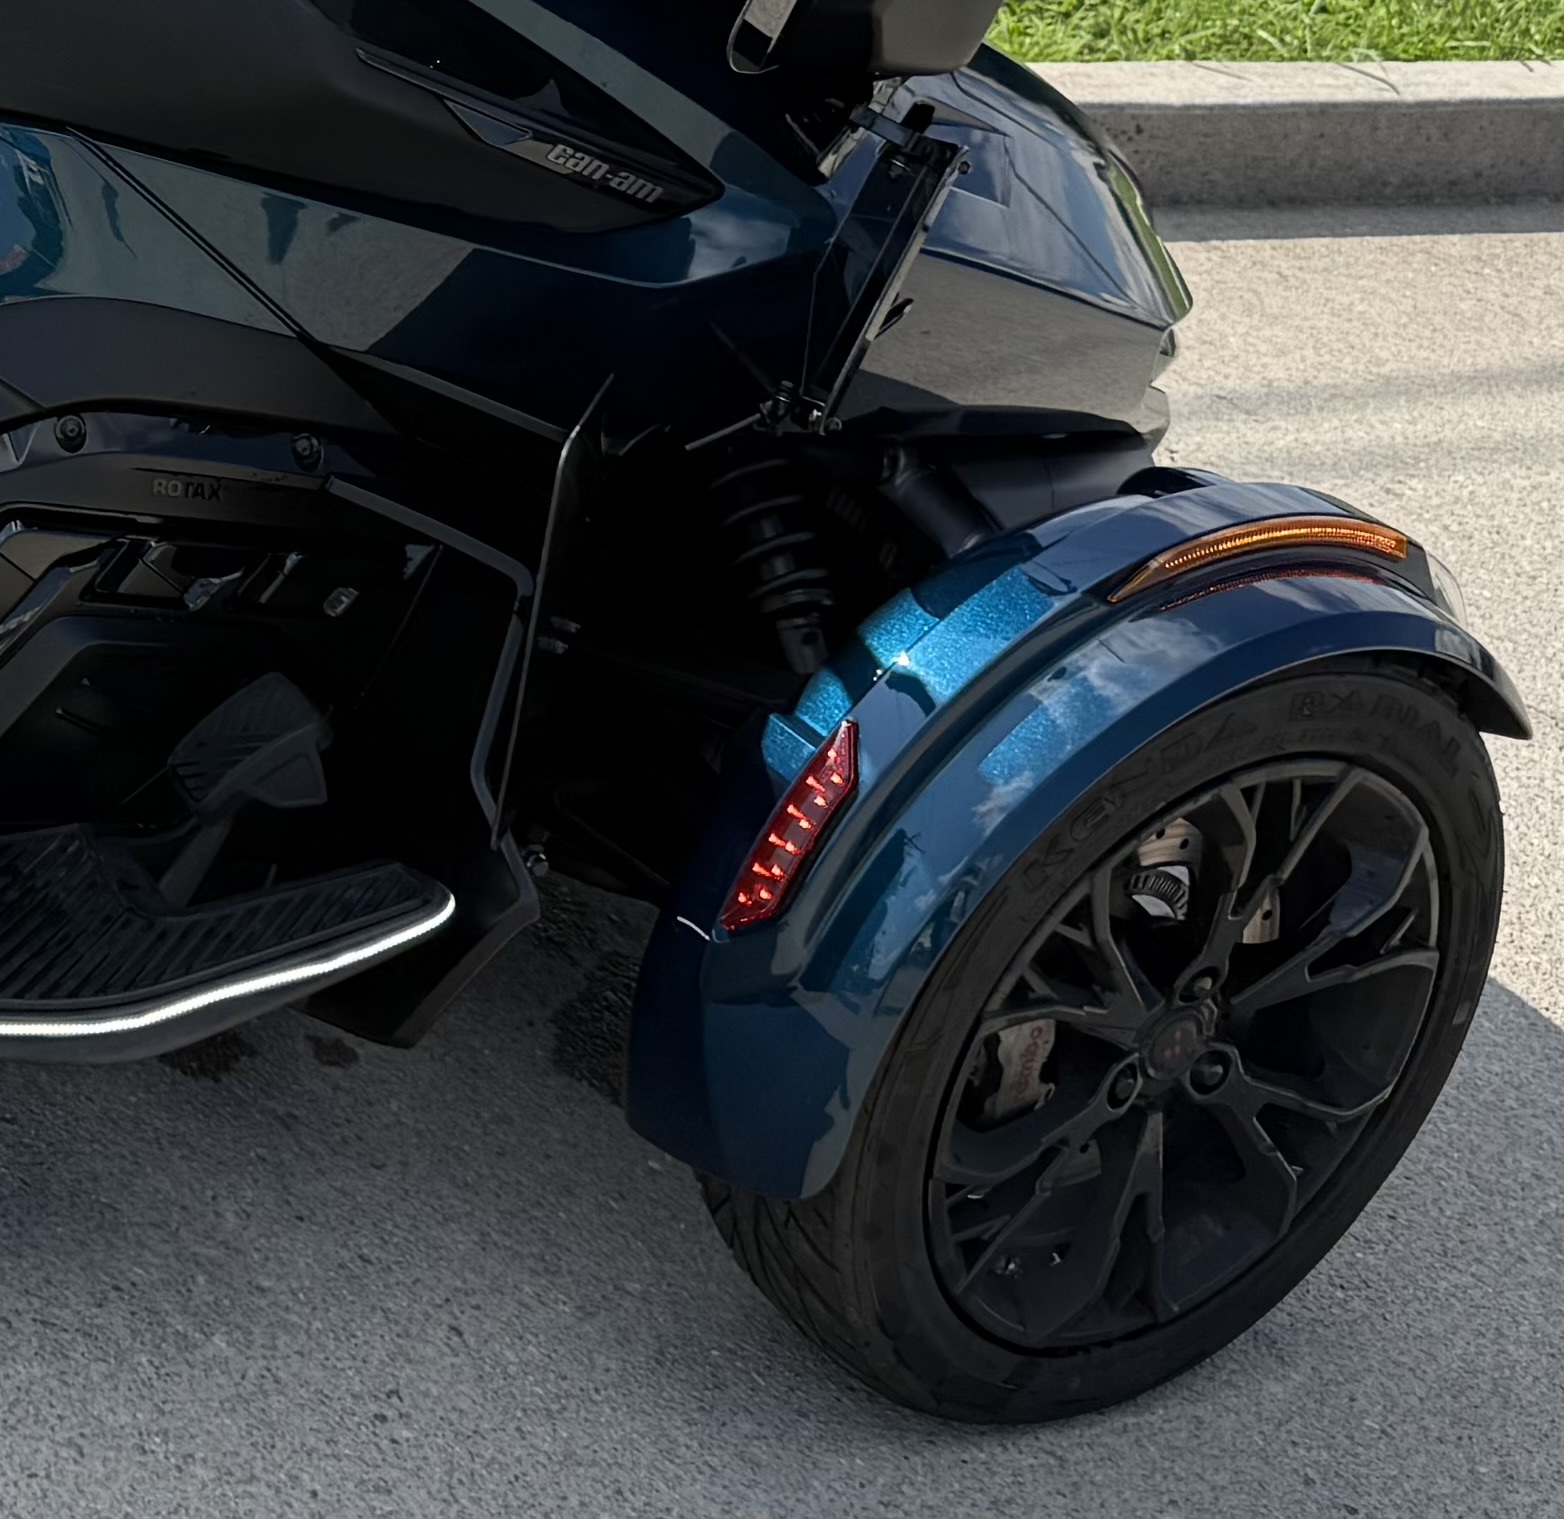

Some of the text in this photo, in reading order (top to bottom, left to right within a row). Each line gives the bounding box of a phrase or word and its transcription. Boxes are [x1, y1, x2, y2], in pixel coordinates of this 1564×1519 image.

[545, 143, 664, 205] can-am
[152, 478, 222, 501] ROTAX
[1022, 690, 1463, 893] KENDA RADIAL
